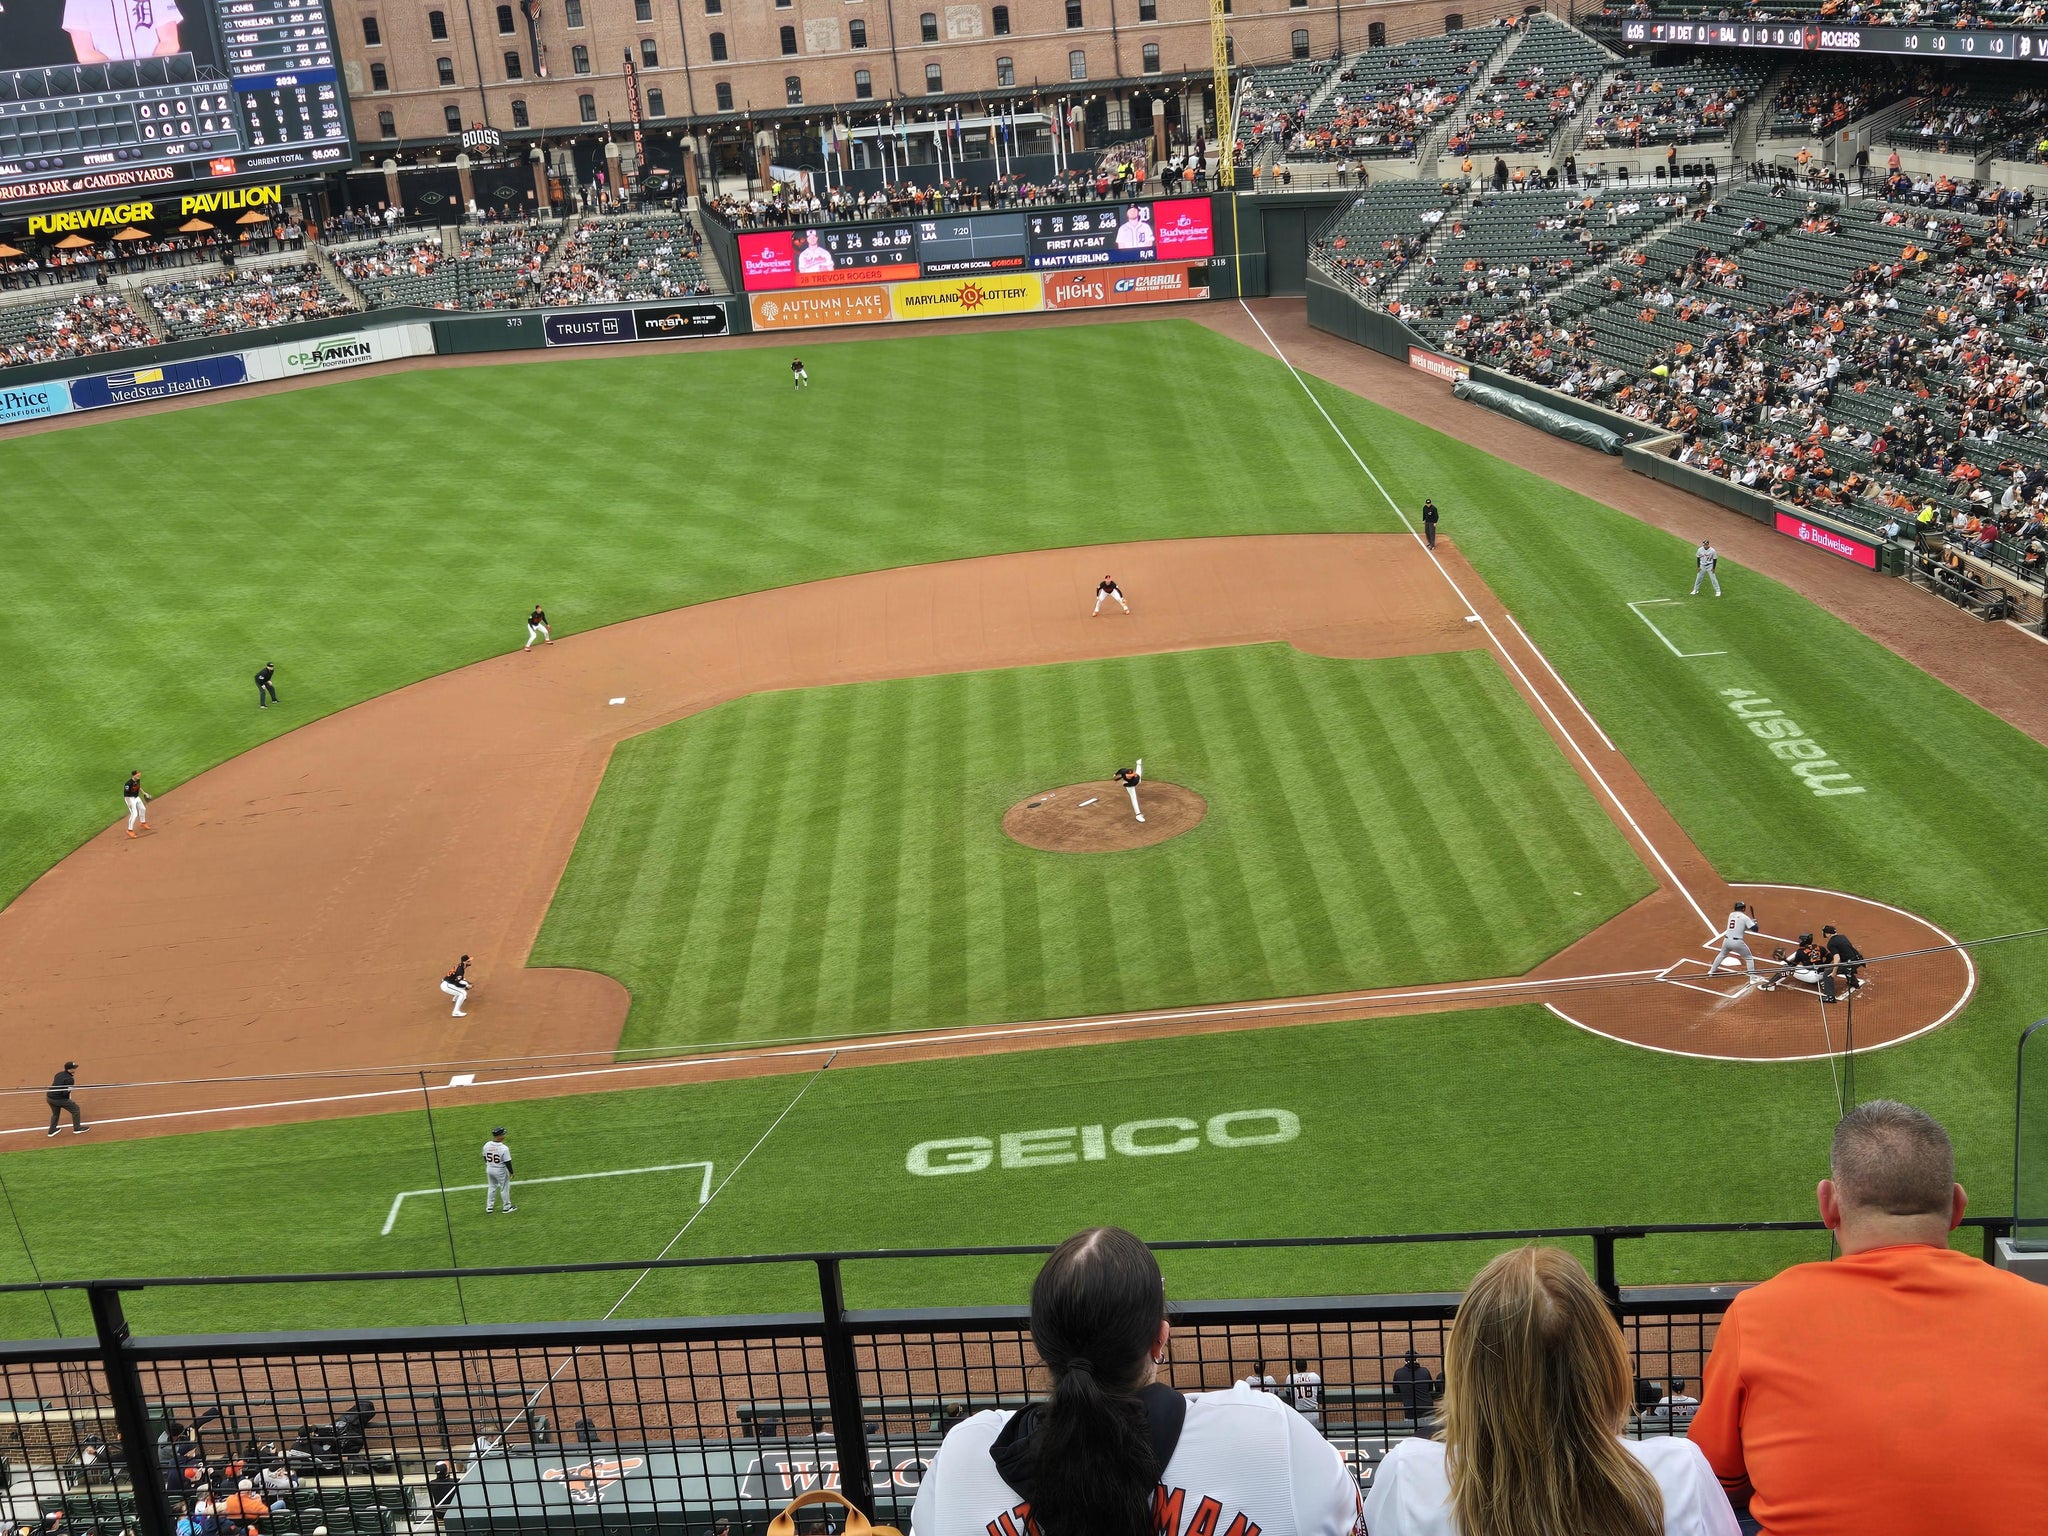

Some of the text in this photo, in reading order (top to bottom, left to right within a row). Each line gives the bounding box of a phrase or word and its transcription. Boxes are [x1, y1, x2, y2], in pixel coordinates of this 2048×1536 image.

[231, 4, 254, 13] JONES
[233, 17, 274, 28] TORKELSON
[1627, 24, 1644, 39] 6:05
[1677, 26, 1693, 40] DET
[1698, 26, 1705, 40] 0
[1719, 26, 1736, 42] BAL
[1742, 28, 1749, 42] 0
[1761, 28, 1768, 43] 0
[1777, 29, 1783, 44] 0
[1793, 29, 1800, 44] 0
[1820, 31, 1860, 48] ROGERS
[1905, 35, 1910, 47] B
[1911, 34, 1918, 49] 0
[1932, 37, 1938, 48] S
[1938, 35, 1945, 50] 0
[1960, 38, 1966, 49] T
[1967, 36, 1974, 51] 0
[1990, 39, 1996, 51] K
[1996, 38, 2003, 53] 0
[239, 49, 253, 57] LEE
[242, 63, 266, 73] SHORT
[276, 76, 297, 86] 2026
[138, 82, 228, 99] R H E MVR ABS
[140, 96, 227, 118] 0 0 0 4 2
[246, 99, 257, 108] 28
[274, 96, 280, 105] 4
[297, 94, 306, 102] 21
[144, 116, 231, 138] 0 0 0 4 2
[251, 118, 260, 126] 12
[253, 137, 264, 145] 49
[281, 134, 287, 142] 0
[0, 144, 185, 174] BALL STRIKE OUT
[247, 148, 340, 167] CURRENT TOTAL $5,000
[0, 166, 174, 199] RIOLE PARK at CAMDEN YARDS
[28, 184, 281, 236] PUREWAGER PAVILION
[1051, 216, 1063, 224] RBI
[1072, 214, 1087, 222] OBP
[1099, 212, 1113, 220] OPS
[921, 222, 936, 231] TEX
[1034, 225, 1041, 234] 4
[1053, 223, 1063, 232] 21
[1098, 219, 1116, 229] .668
[1159, 227, 1208, 237] Budweiser
[831, 235, 911, 250] 8 2-5 38.0 6.87
[922, 232, 938, 240] LAA
[1046, 236, 1105, 250] FIRST AT-BAT
[846, 252, 902, 265] 0 0 0
[1034, 249, 1153, 266] 8 MATT VIERLING R/R
[1210, 258, 1225, 266] 318
[745, 260, 792, 270] Budweiser
[927, 264, 951, 272] FOLLOW
[970, 260, 991, 269] SOCIAL
[800, 271, 882, 284] 28 TREVOR ROGERS
[1134, 273, 1182, 286] CARROLL
[1055, 281, 1104, 303] HIGH'S
[1134, 284, 1160, 292] MOTOR
[905, 287, 1027, 306] MARYLAND LOTTERY
[782, 294, 881, 313] AUTUMN LAKE
[782, 308, 882, 320] HEALTHCARE
[507, 318, 522, 327] 373
[556, 322, 599, 335] TRUIST
[645, 317, 684, 329] masn
[1410, 353, 1427, 368] weis
[110, 377, 212, 403] MedStar Health
[0, 407, 51, 419] CONFIDENCE
[1811, 528, 1854, 556] Budweiser
[1729, 919, 1735, 929] 8
[905, 1108, 1301, 1177] GEICO
[487, 1152, 500, 1163] 56
[1297, 1383, 1313, 1399] 18
